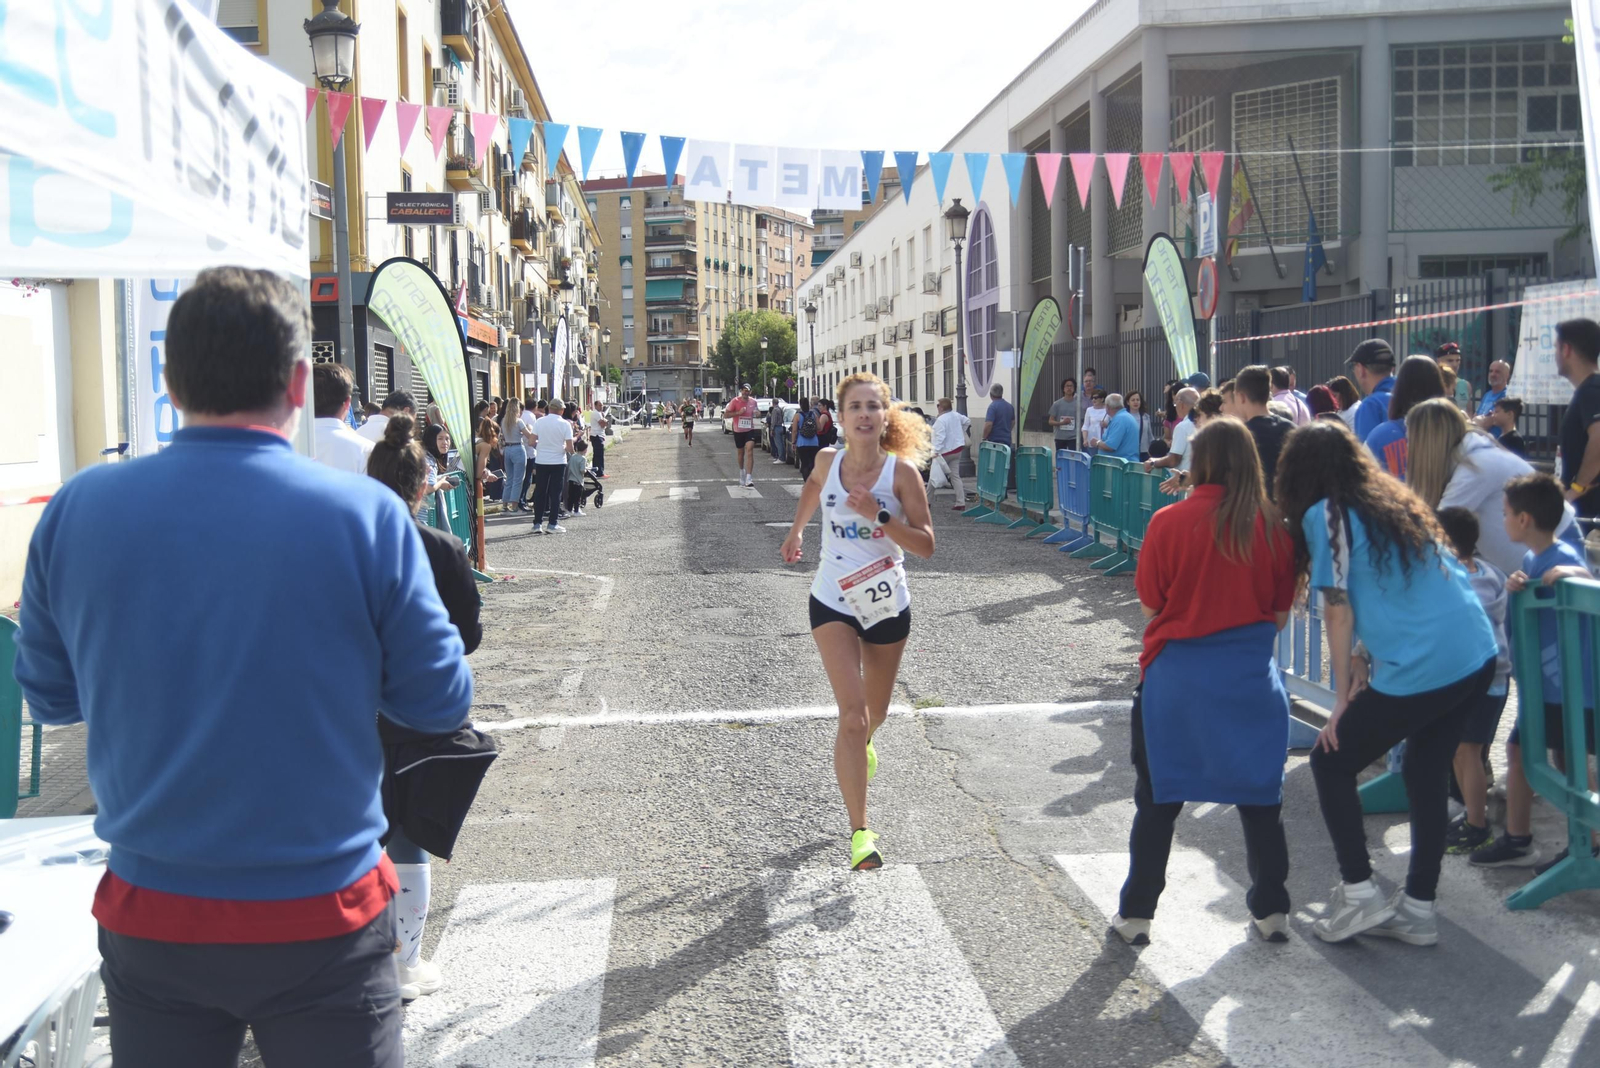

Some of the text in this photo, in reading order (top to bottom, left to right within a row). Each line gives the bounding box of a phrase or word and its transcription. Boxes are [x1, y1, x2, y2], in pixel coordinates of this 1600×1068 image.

[390, 208, 452, 216] CABALLERO
[1199, 201, 1210, 250] P
[865, 581, 892, 604] 29
